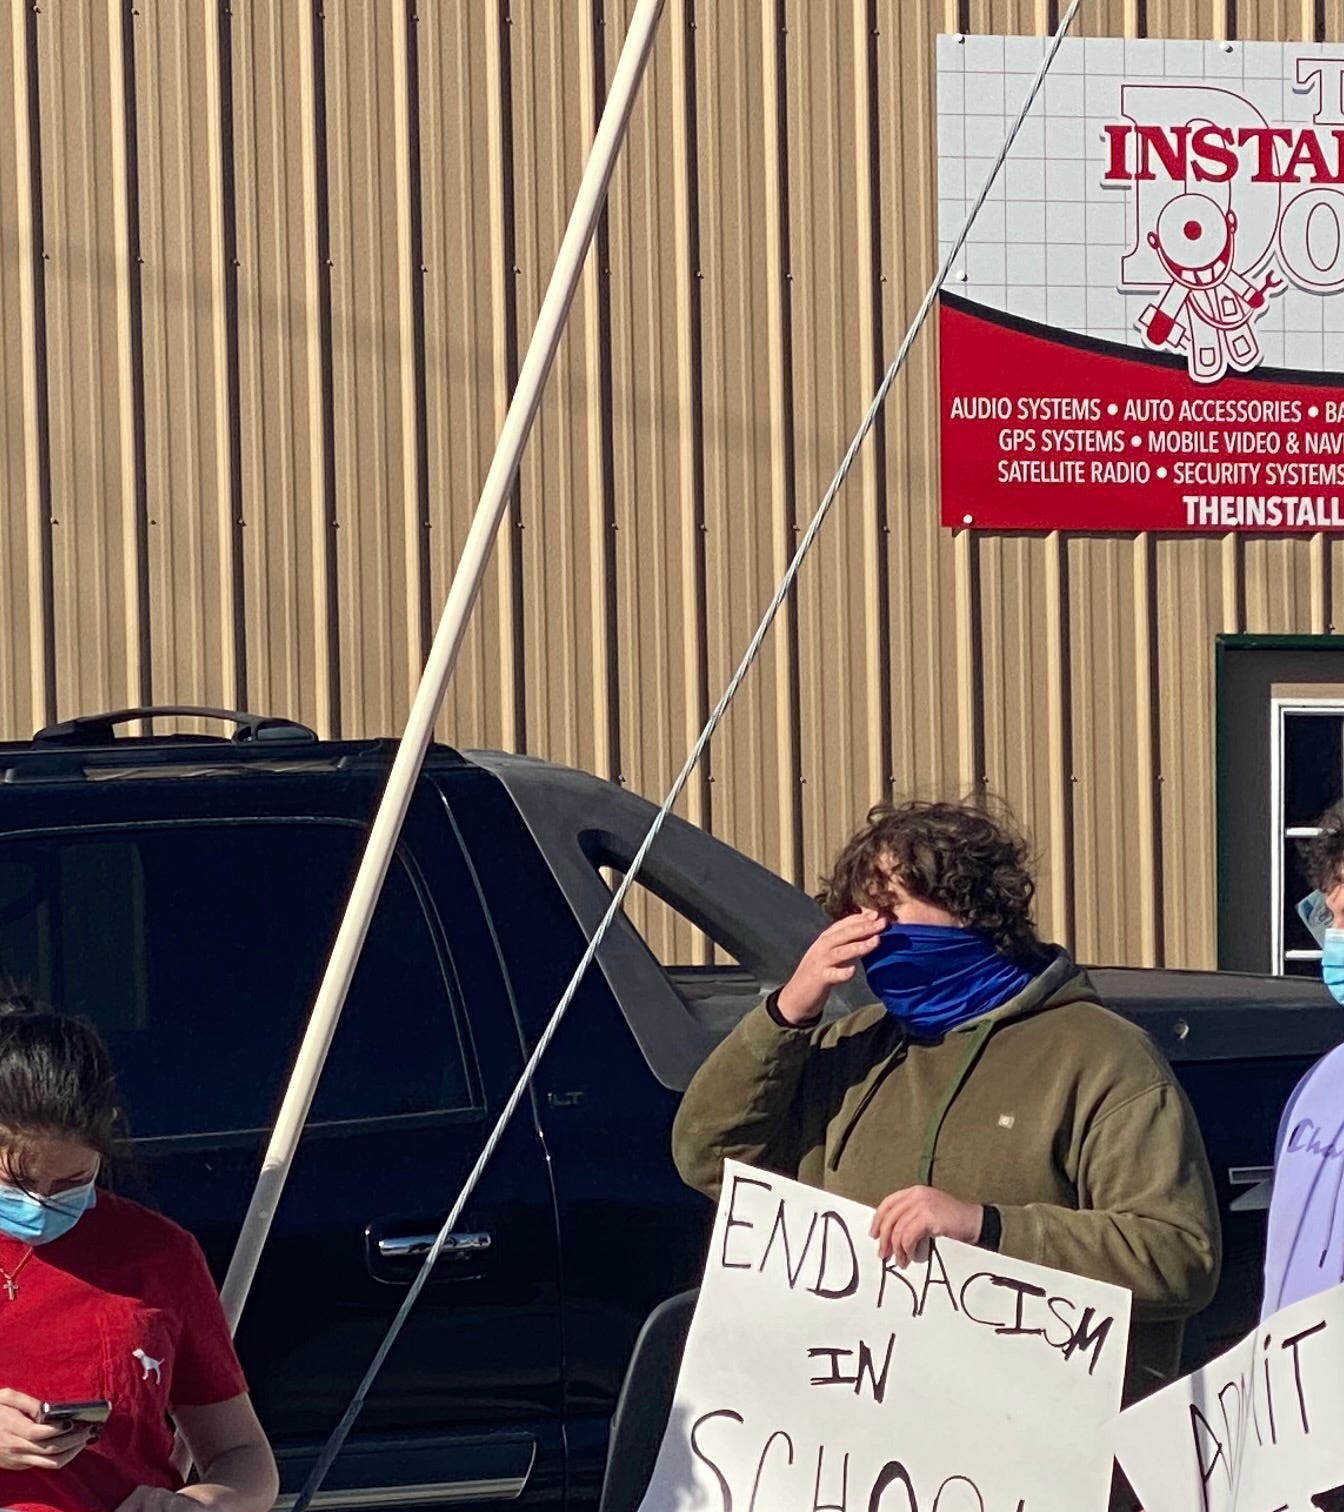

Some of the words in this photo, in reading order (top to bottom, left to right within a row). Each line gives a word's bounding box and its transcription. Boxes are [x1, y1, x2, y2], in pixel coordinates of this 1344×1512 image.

[951, 397, 1012, 420] AUDIO
[1018, 398, 1101, 420] SYSTEMS
[1123, 399, 1174, 421] AUTO
[1179, 400, 1302, 422] ACCESSORIES
[999, 429, 1035, 451] GPS
[1041, 429, 1124, 452] SYSTEMS
[1148, 430, 1219, 453] MOBILE
[1224, 431, 1280, 454] VIDEO
[1286, 432, 1299, 454] &
[998, 460, 1085, 483] SATELLITE
[1091, 461, 1150, 484] RADIO
[1173, 462, 1261, 485] SECURITY
[721, 1176, 860, 1299] END
[877, 1236, 1115, 1376] RACISM
[807, 1333, 896, 1403] IN
